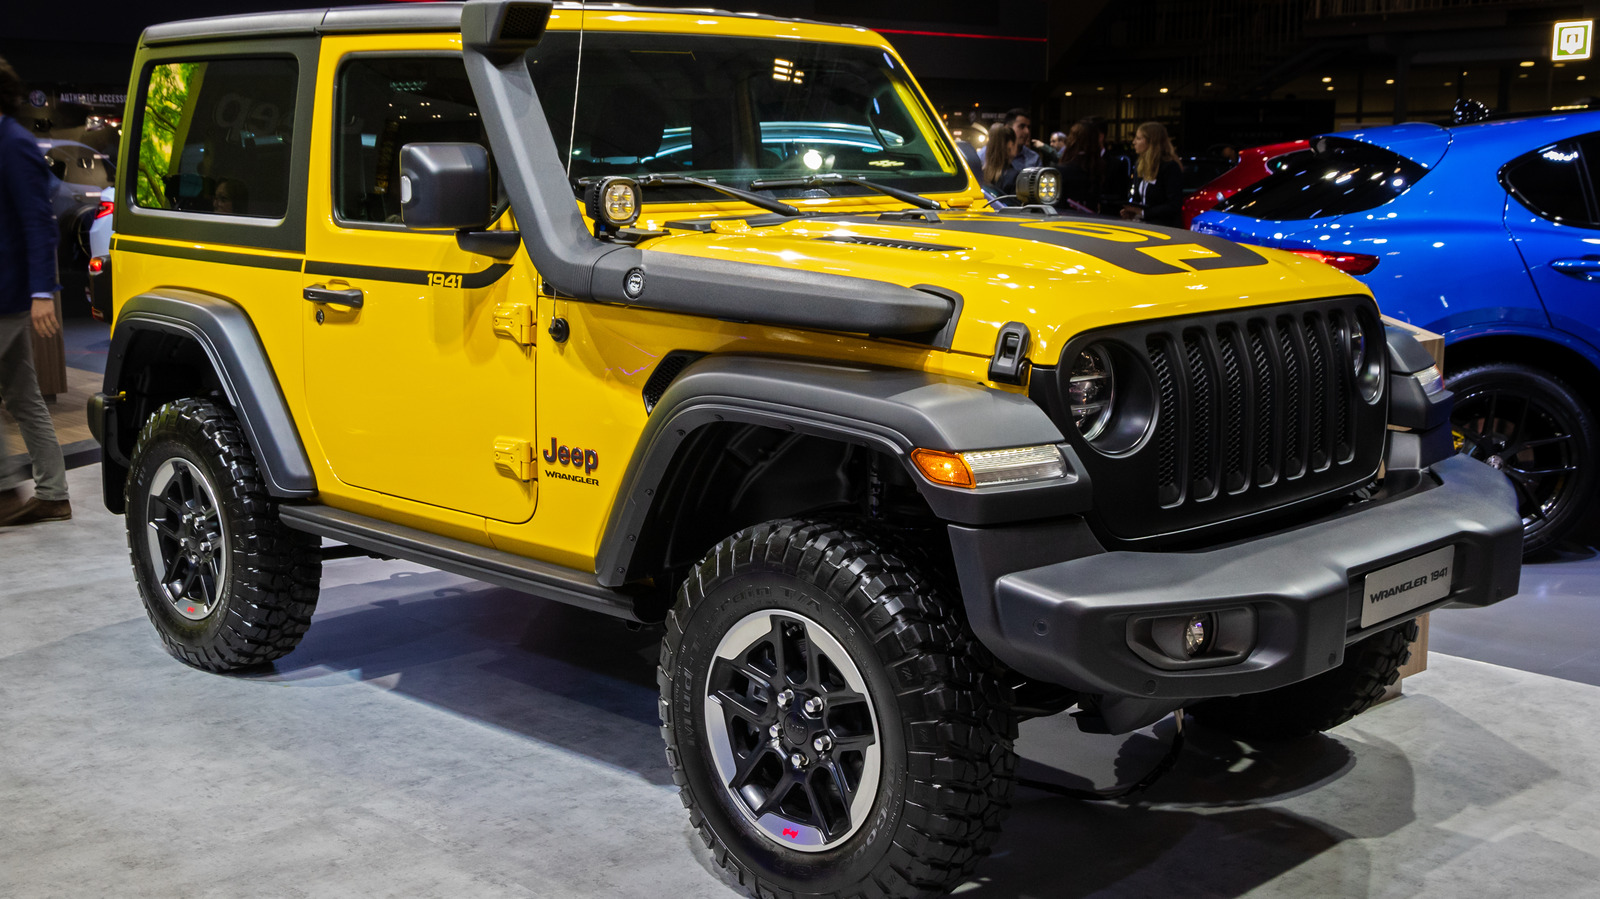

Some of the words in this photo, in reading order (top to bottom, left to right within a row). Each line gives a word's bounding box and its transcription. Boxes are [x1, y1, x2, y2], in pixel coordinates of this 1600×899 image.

[427, 272, 463, 289] 1941
[543, 437, 599, 475] Jeep
[544, 469, 599, 486] WRANGLER
[1369, 575, 1427, 604] WRANGLER
[1430, 566, 1449, 582] 1941
